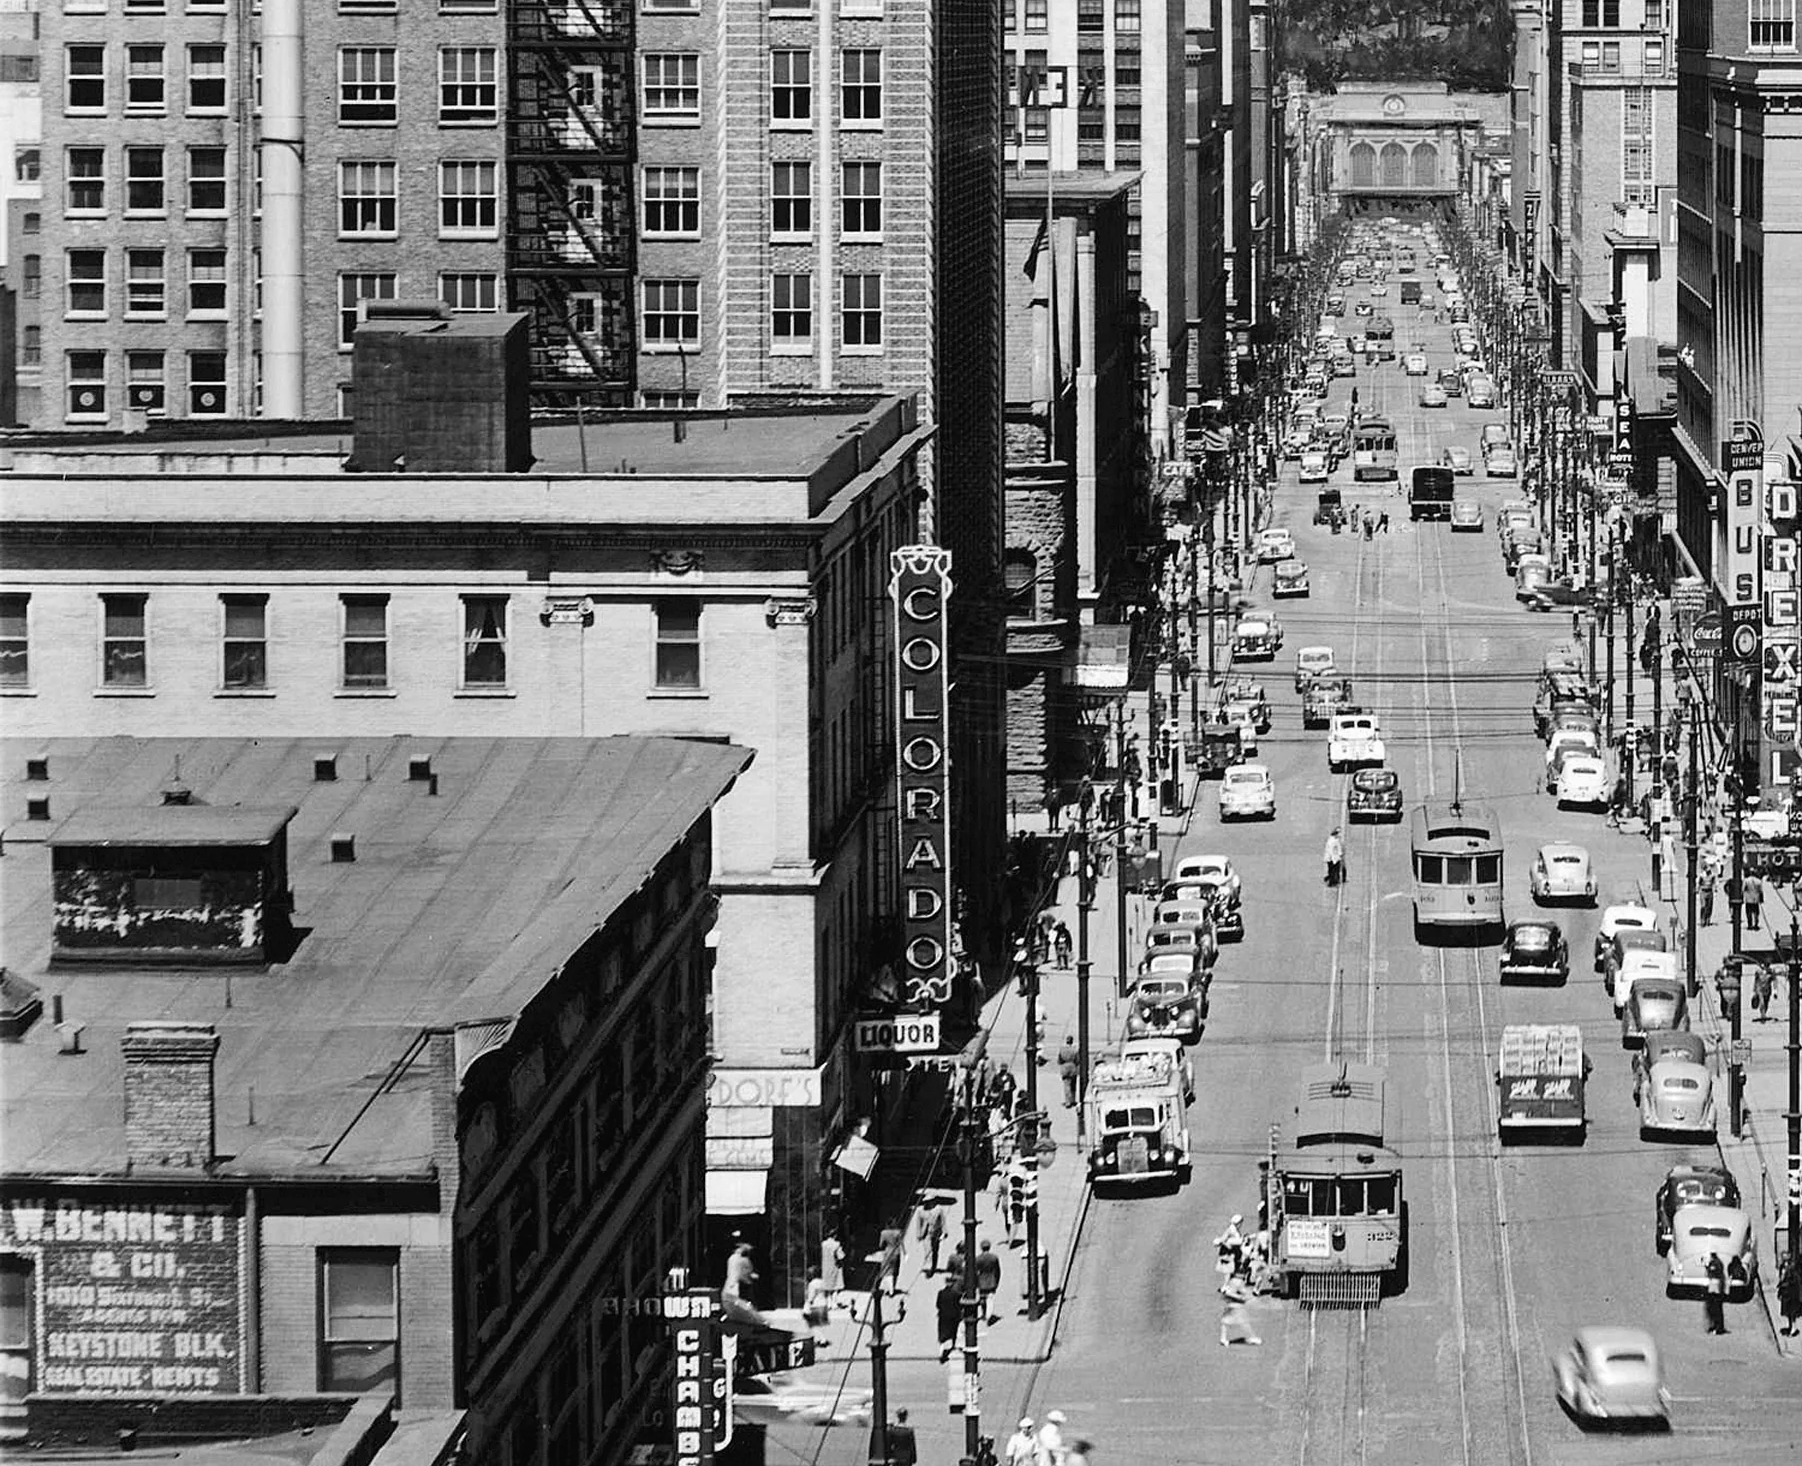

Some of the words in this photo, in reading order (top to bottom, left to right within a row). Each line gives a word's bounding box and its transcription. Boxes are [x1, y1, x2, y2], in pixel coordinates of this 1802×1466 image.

[1731, 456, 1763, 468] UNION
[1736, 479, 1753, 602] BUS
[1732, 608, 1763, 622] DEPOT
[1772, 485, 1798, 785] DREXEL
[903, 587, 941, 969] COLORADO
[860, 1023, 935, 1046] LIQUOR
[91, 1251, 121, 1278] &
[48, 1332, 163, 1359] KEYSTONE
